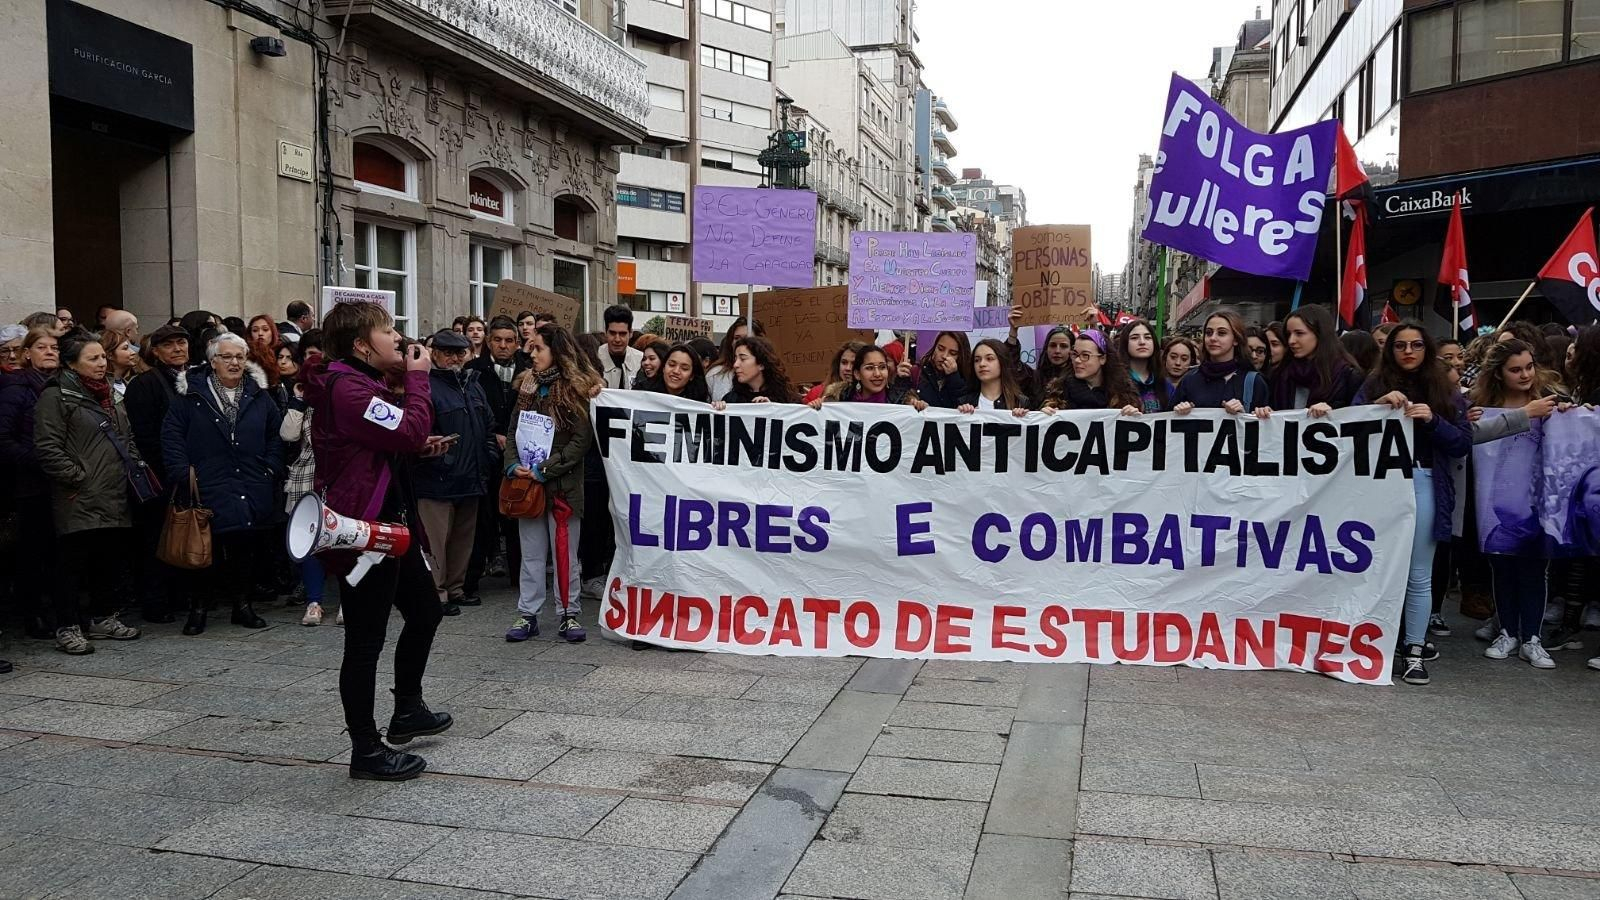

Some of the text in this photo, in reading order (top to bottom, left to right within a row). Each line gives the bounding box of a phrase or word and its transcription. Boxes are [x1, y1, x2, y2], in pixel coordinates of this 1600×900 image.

[73, 47, 173, 85] PURIFICACION GARCIA
[1163, 89, 1315, 187] FOLGA
[1152, 149, 1168, 174] e
[469, 191, 500, 211] nkinter.
[717, 193, 749, 217] EL
[1386, 186, 1472, 214] CaixaBank
[1142, 178, 1326, 256] ulleres
[704, 223, 801, 248] NO DEFINE
[708, 249, 814, 271] LA CAPACIDAD
[1015, 245, 1089, 273] PERSONAS
[1040, 270, 1060, 288] NO
[342, 291, 366, 299] CAMINO
[1021, 286, 1087, 309] OBJETOS
[669, 316, 699, 328] TETAS
[825, 311, 848, 324] QU
[525, 413, 544, 423] MARZO
[594, 405, 1414, 480] FEMINISMO ANTICAPITALISTA
[628, 493, 1377, 575] LIBRES E COMBATIVAS
[604, 576, 1385, 682] SINDICATO DE ESTUDANTES
